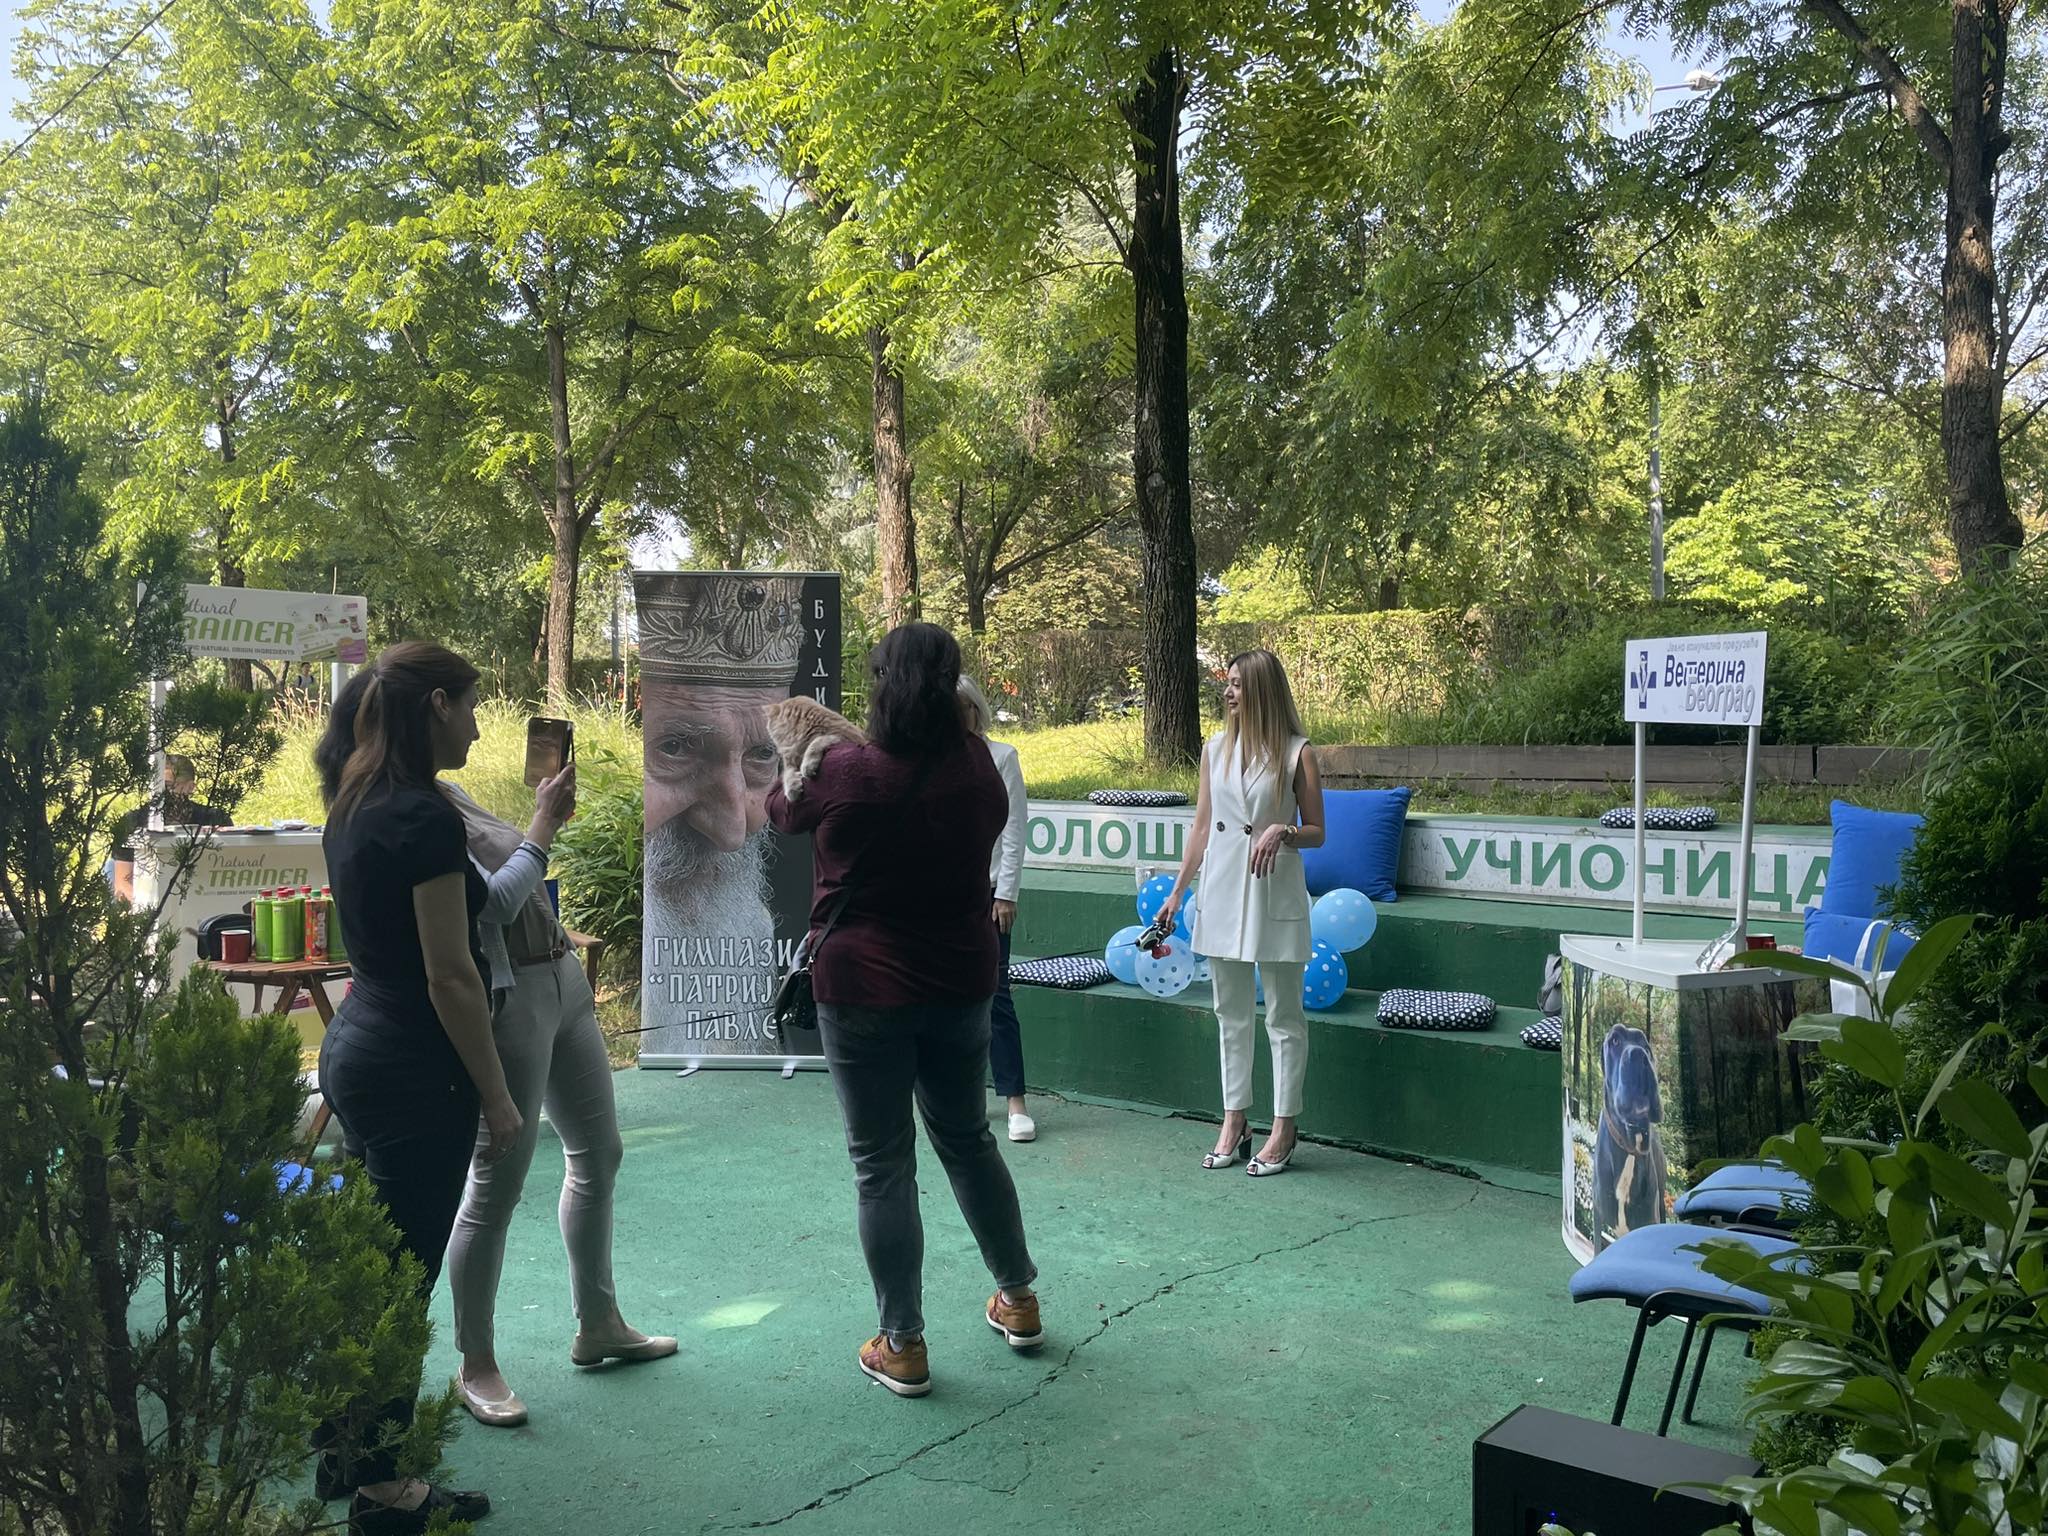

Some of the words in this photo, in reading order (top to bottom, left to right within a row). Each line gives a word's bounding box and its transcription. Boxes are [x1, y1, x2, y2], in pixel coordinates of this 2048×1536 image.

[184, 616, 295, 645] RAINER
[1686, 677, 1756, 723] Београд
[208, 853, 266, 868] Natural
[1026, 816, 1183, 862] ОЛОШ
[1442, 836, 1832, 912] УЧИОНИЦА
[208, 868, 308, 888] TRAINER
[653, 936, 793, 968] ГИМНАЗИ
[649, 973, 787, 1003] “ПАТРИЈ
